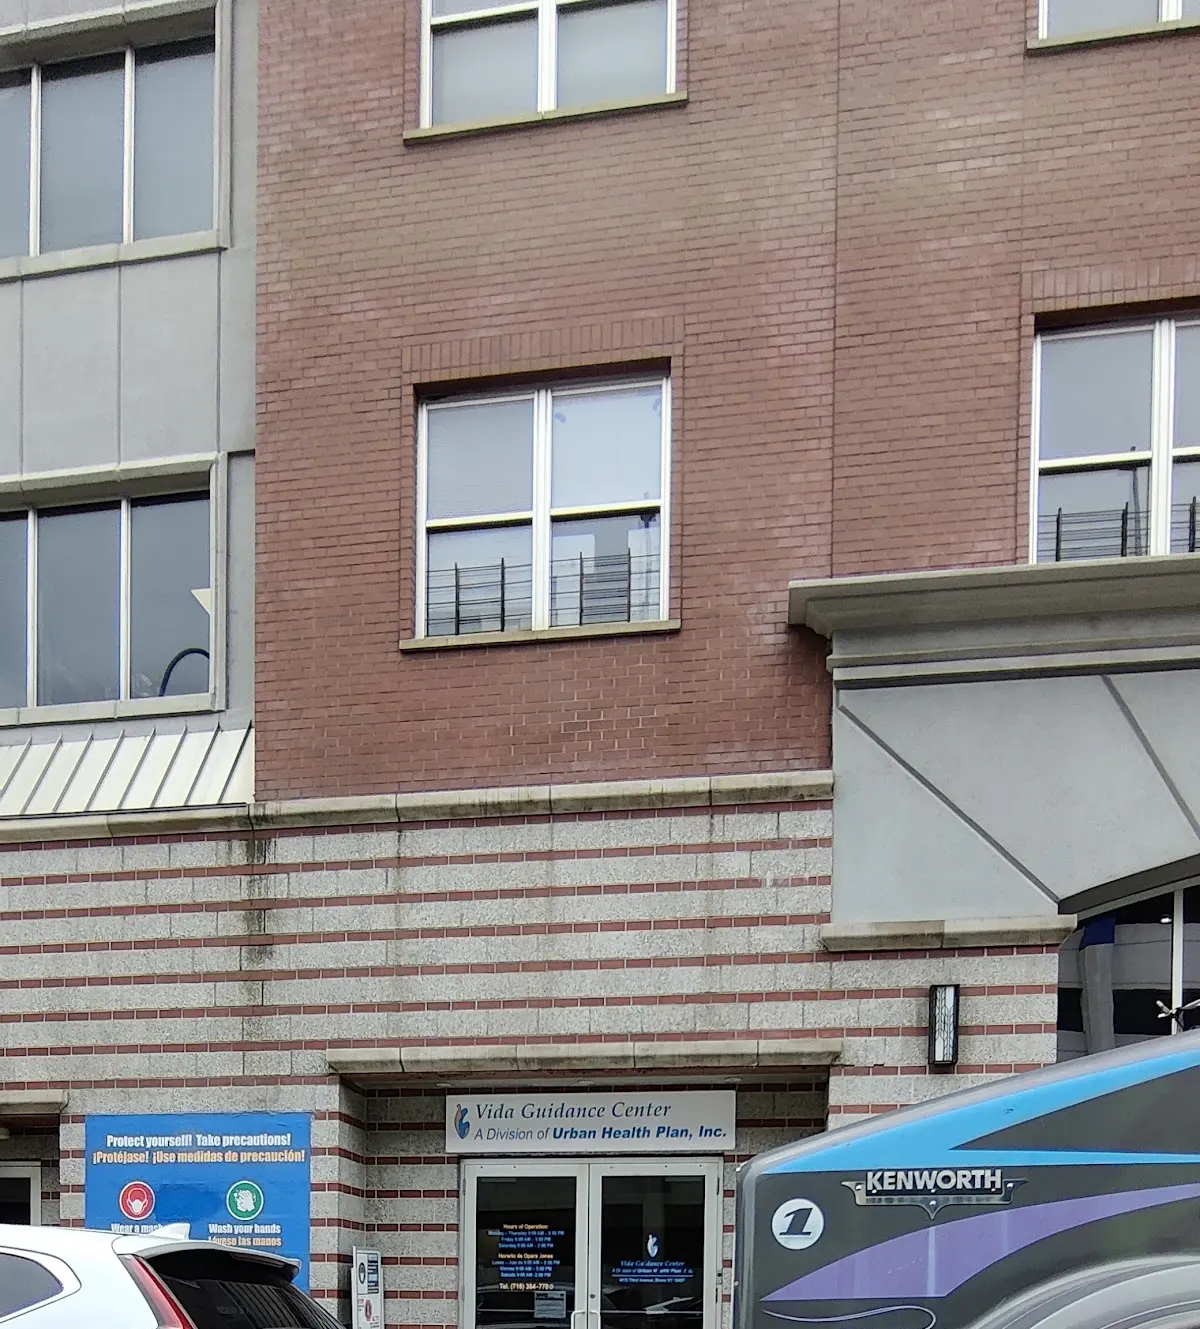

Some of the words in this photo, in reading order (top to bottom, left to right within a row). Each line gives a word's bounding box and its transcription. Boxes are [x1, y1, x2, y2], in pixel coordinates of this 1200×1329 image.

[476, 1103, 514, 1119] Vida
[521, 1102, 605, 1119] Guidance
[612, 1101, 672, 1118] Center
[473, 1128, 483, 1140] A
[486, 1127, 533, 1140] Division
[537, 1127, 551, 1140] of
[553, 1127, 597, 1139] Urban
[602, 1126, 651, 1139] Health
[655, 1125, 693, 1140] Plan,
[698, 1125, 727, 1138] Inc.
[106, 1134, 145, 1147] Protect
[146, 1134, 193, 1149] yourself!
[195, 1133, 221, 1147] Take
[222, 1133, 291, 1148] precautions!
[92, 1150, 149, 1165] ¡Protéjase!
[152, 1150, 176, 1165] ¡Use
[176, 1150, 224, 1163] medidas
[225, 1150, 238, 1163] de
[239, 1149, 306, 1165] precaución!
[866, 1168, 1002, 1191] KENWORTH
[110, 1223, 133, 1233] Wear
[134, 1224, 140, 1233] a
[208, 1223, 233, 1234] Wash
[233, 1224, 253, 1235] your
[254, 1223, 281, 1234] hands
[238, 1235, 252, 1246] las
[252, 1237, 282, 1247] manos
